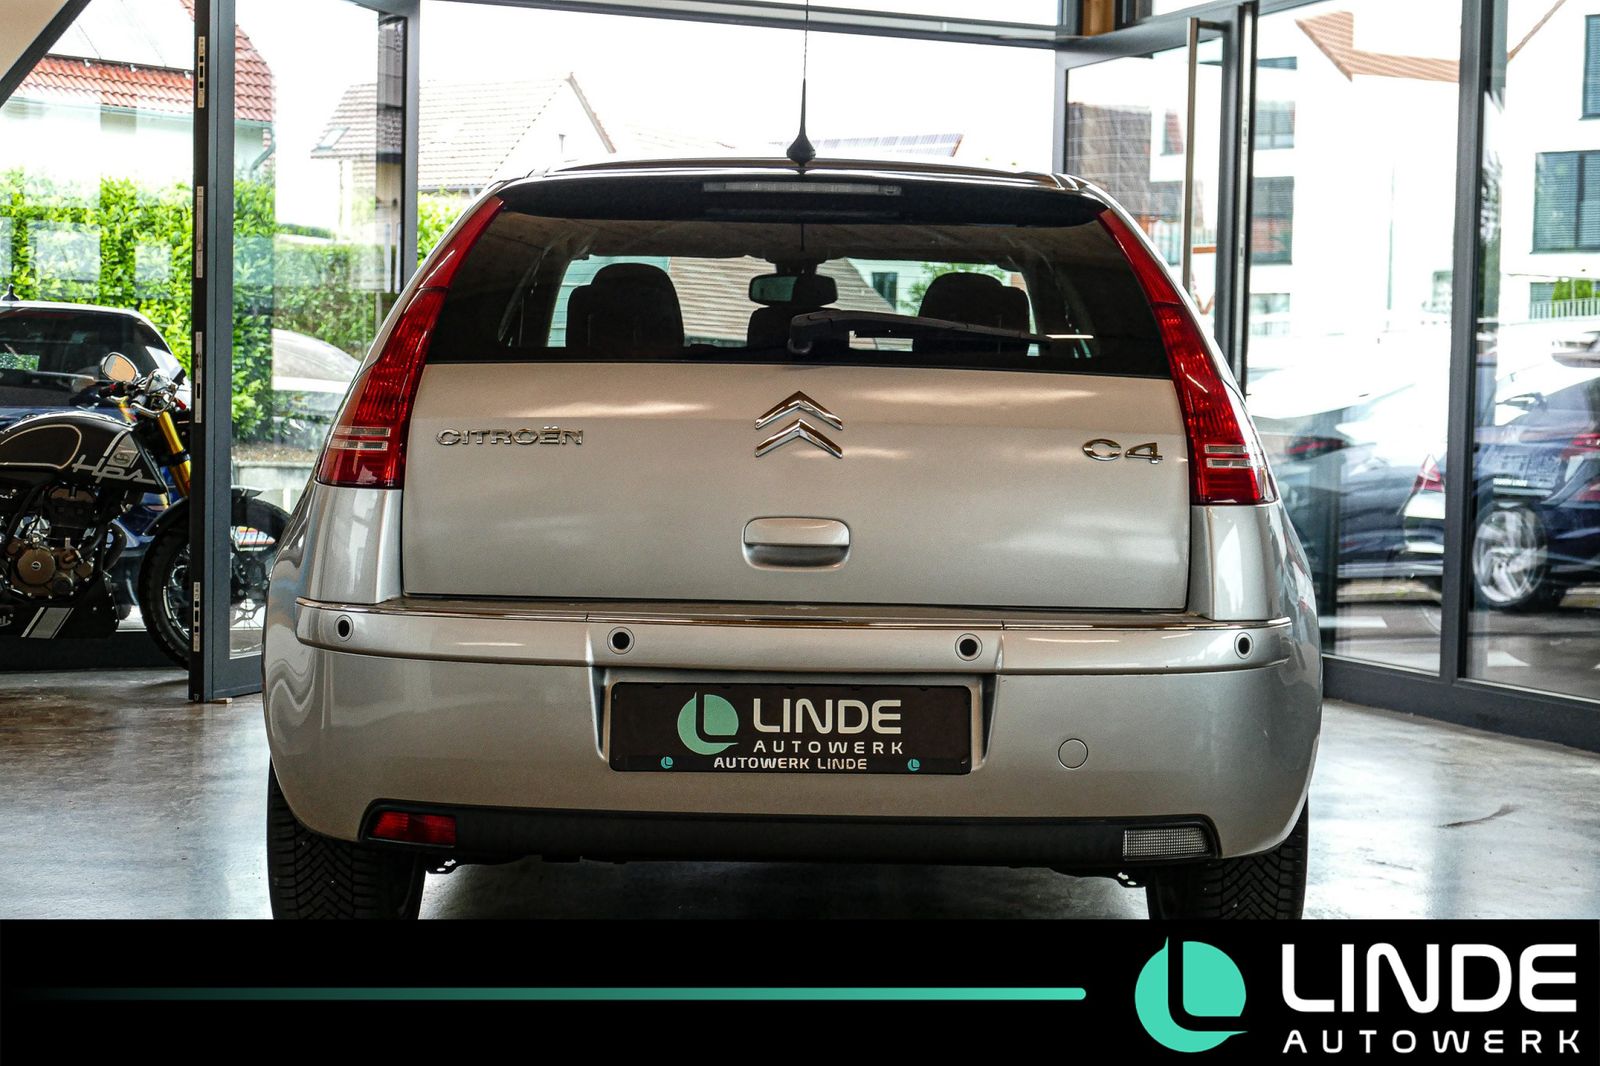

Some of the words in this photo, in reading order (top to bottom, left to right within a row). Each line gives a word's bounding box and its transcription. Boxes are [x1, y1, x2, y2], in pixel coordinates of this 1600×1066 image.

[435, 425, 584, 446] CITROËN
[1082, 438, 1163, 465] C4
[753, 698, 902, 735] LINDE
[753, 740, 904, 755] AUTOWERK
[713, 757, 810, 770] AUTOWERK
[817, 758, 868, 771] LINDE
